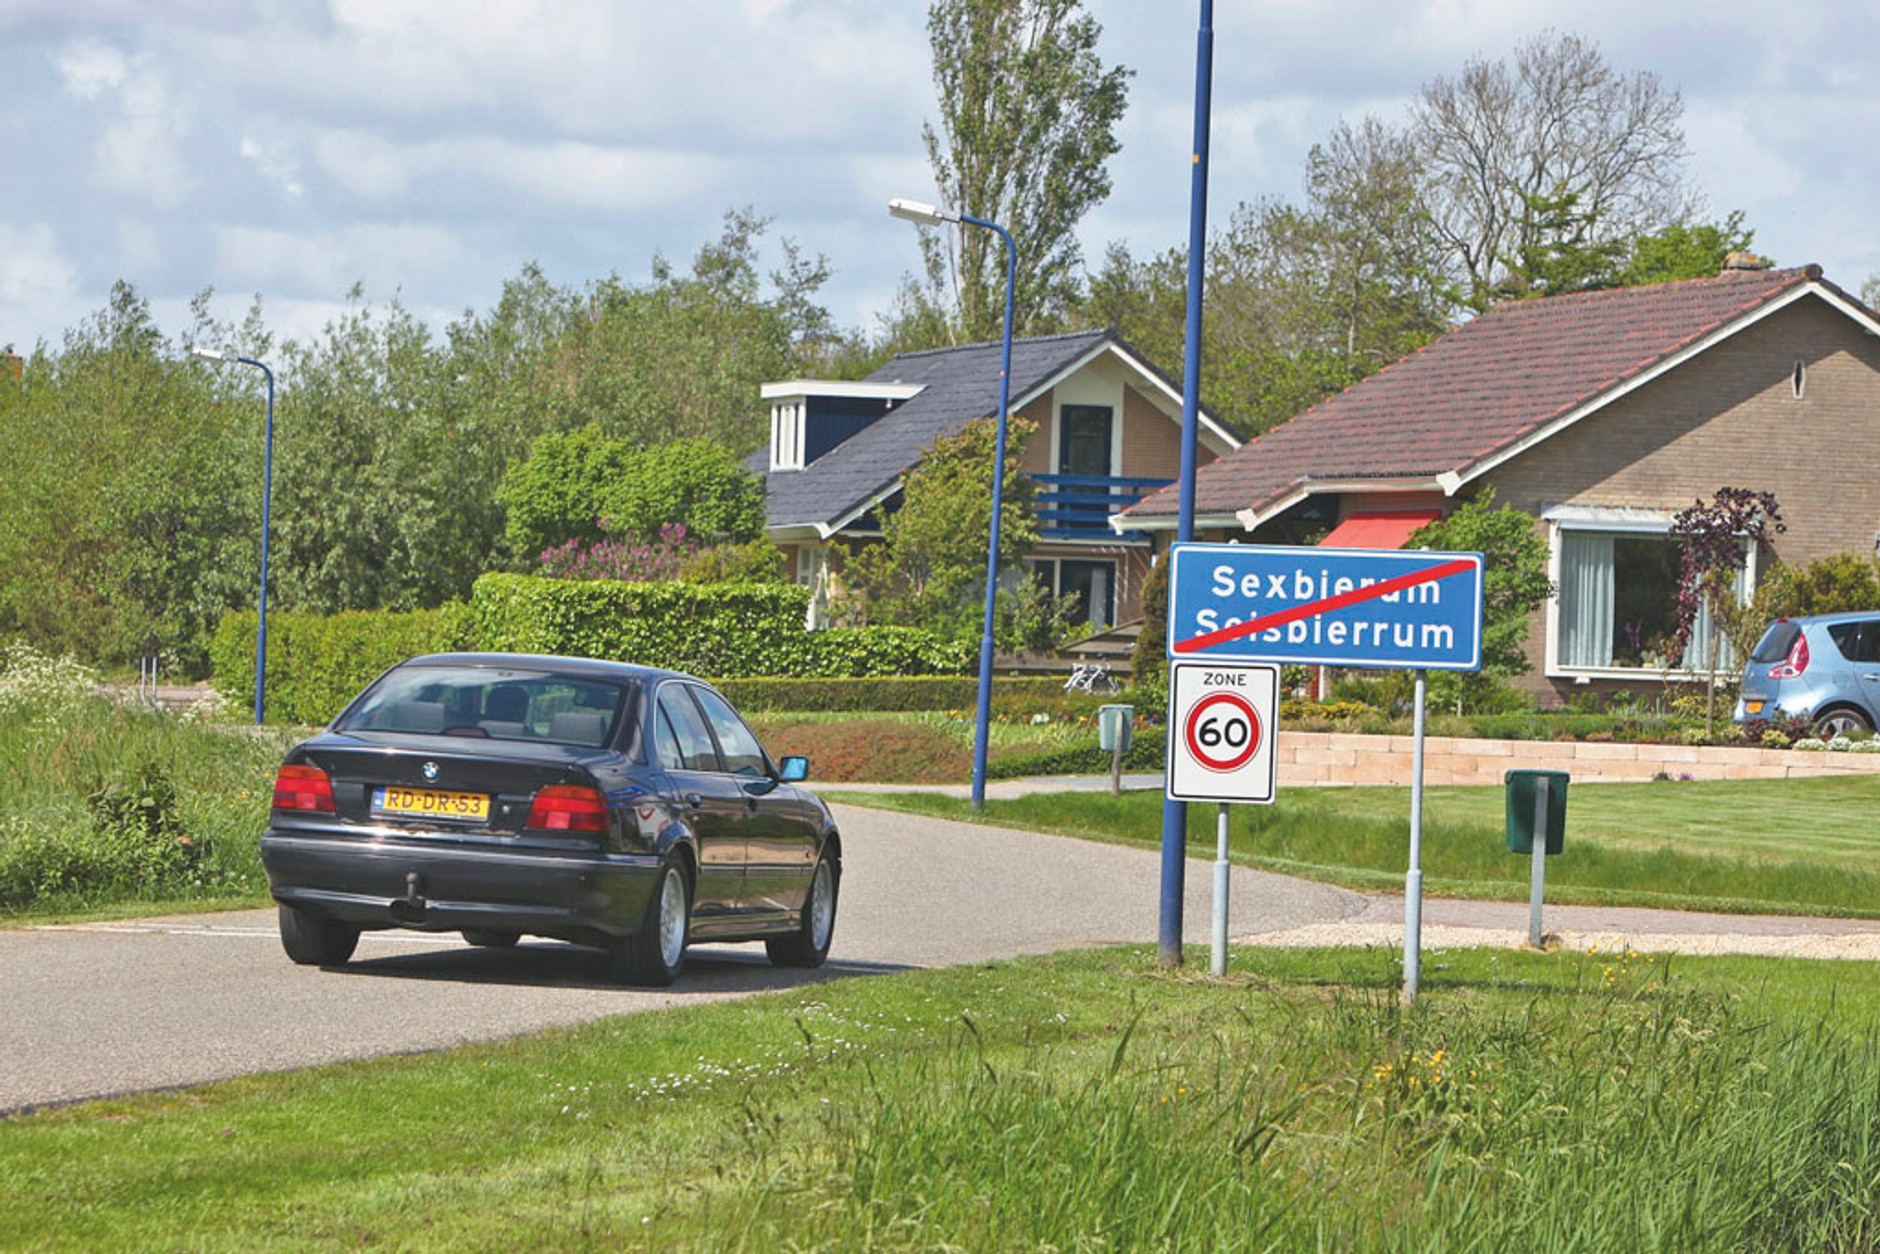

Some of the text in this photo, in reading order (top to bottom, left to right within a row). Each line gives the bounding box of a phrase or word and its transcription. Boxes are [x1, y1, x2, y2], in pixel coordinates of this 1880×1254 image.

[1203, 672, 1247, 686] ZONE
[1198, 717, 1248, 748] 60
[387, 789, 481, 814] RD-DR-53
